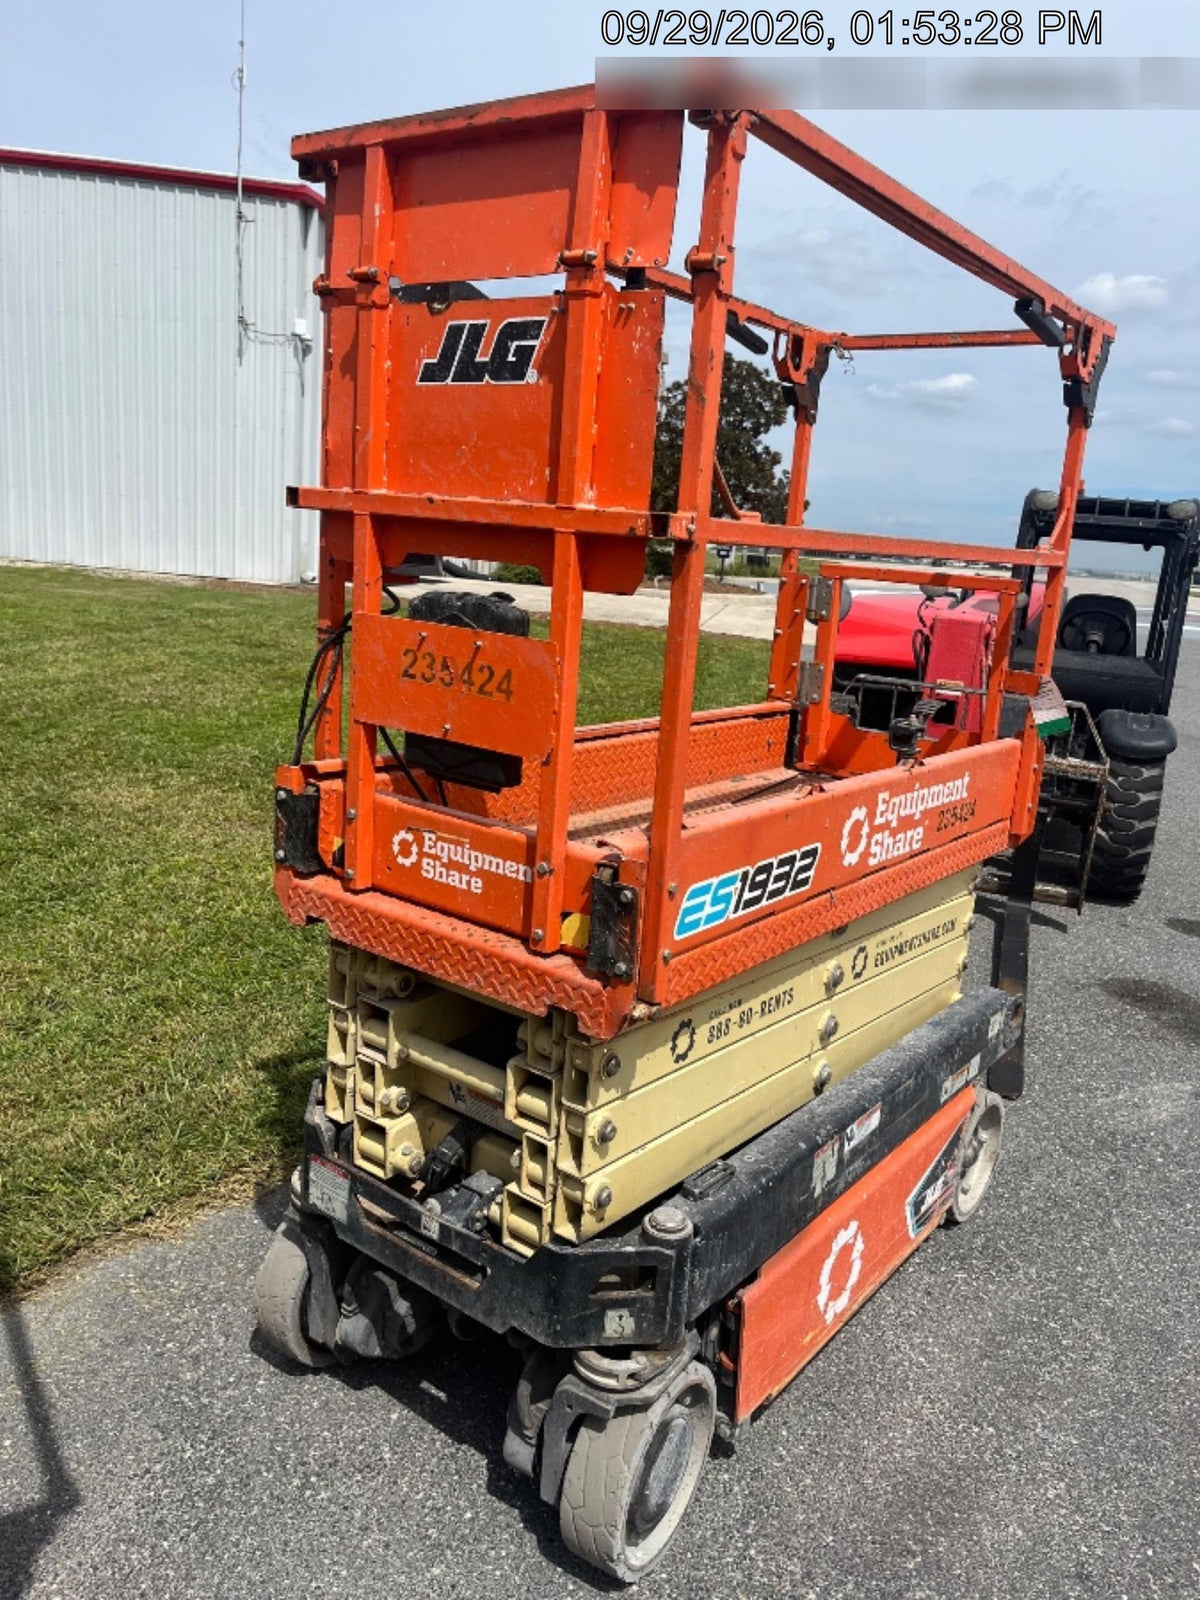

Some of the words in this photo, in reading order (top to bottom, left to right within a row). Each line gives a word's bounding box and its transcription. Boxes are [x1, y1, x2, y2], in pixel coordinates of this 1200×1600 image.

[401, 648, 514, 702] 235424
[874, 771, 971, 828] Equipment
[422, 831, 533, 883] Equipmen
[867, 825, 924, 867] Share
[421, 857, 484, 895] Share
[674, 842, 822, 941] ES1932
